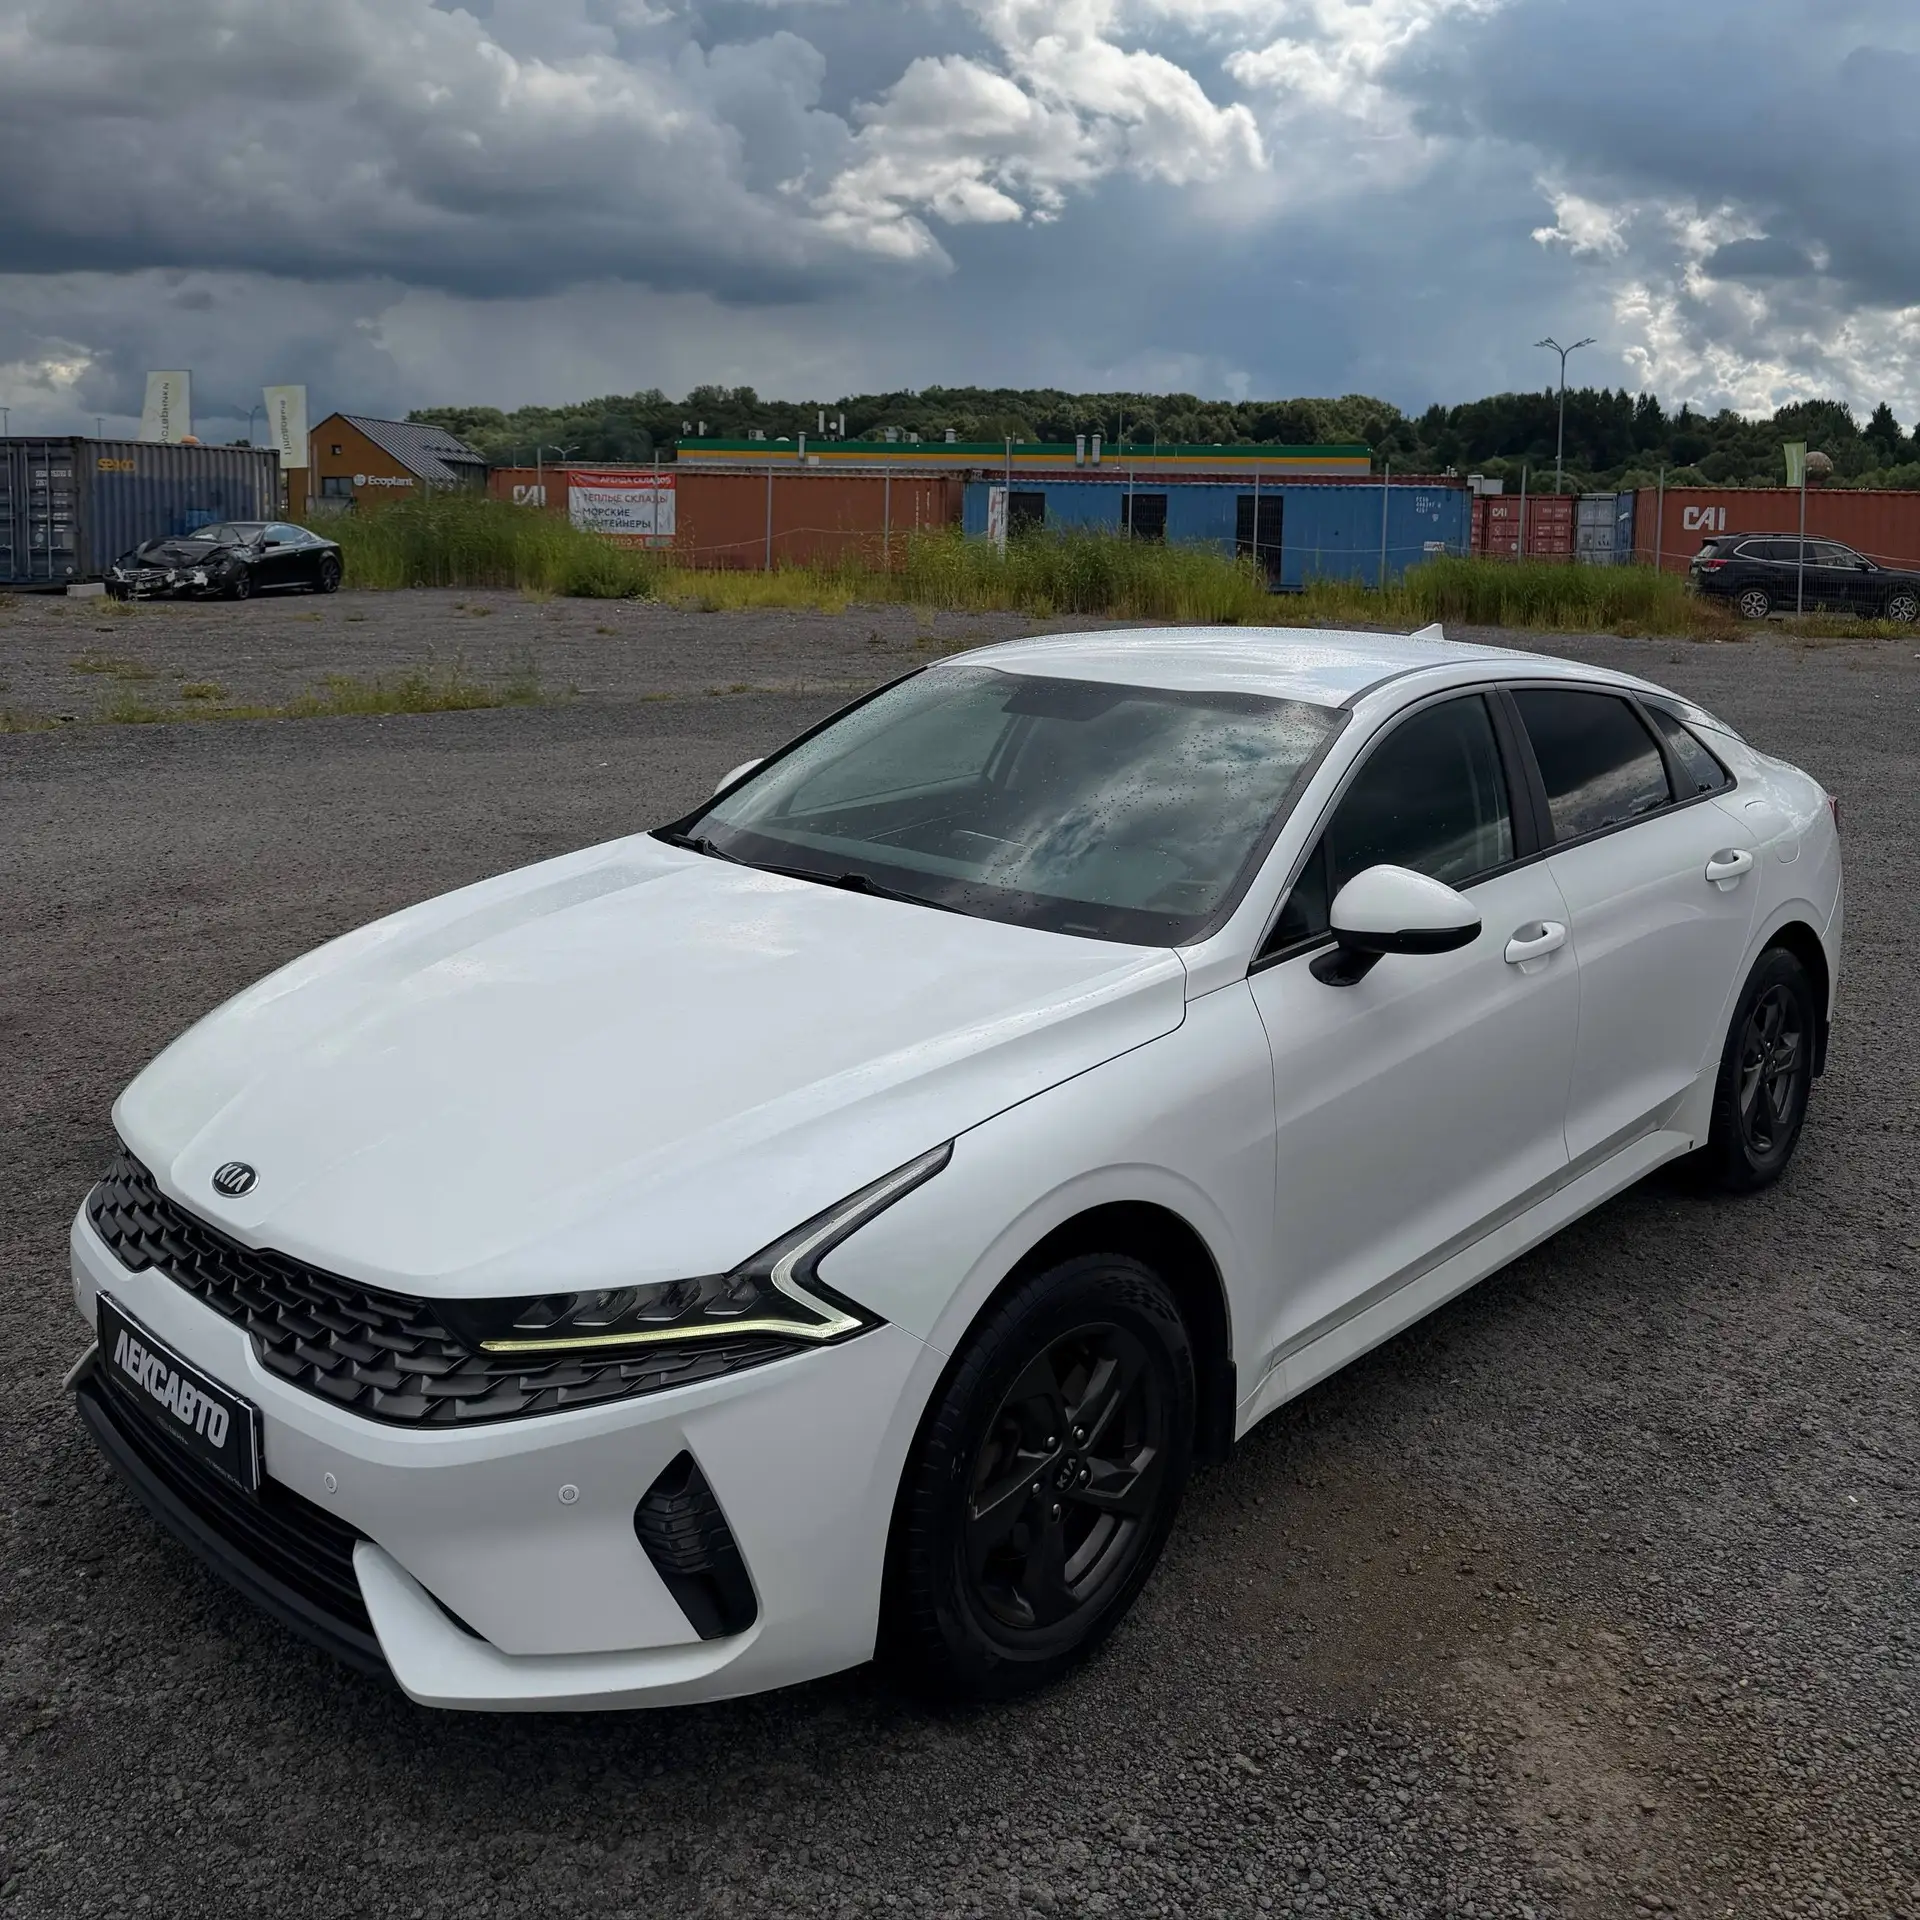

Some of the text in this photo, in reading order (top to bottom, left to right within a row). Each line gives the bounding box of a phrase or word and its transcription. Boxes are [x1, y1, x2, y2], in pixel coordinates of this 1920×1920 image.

[368, 475, 414, 489] Ecoplant
[584, 493, 622, 503] ТЕПЛЫЕ
[583, 507, 631, 517] МОРСКИЕ
[1492, 507, 1507, 517] CAI
[1683, 506, 1726, 531] CAI
[215, 1163, 251, 1193] KIA
[113, 1329, 229, 1449] ЛЕКСАВТО
[1056, 1457, 1077, 1489] KIA
